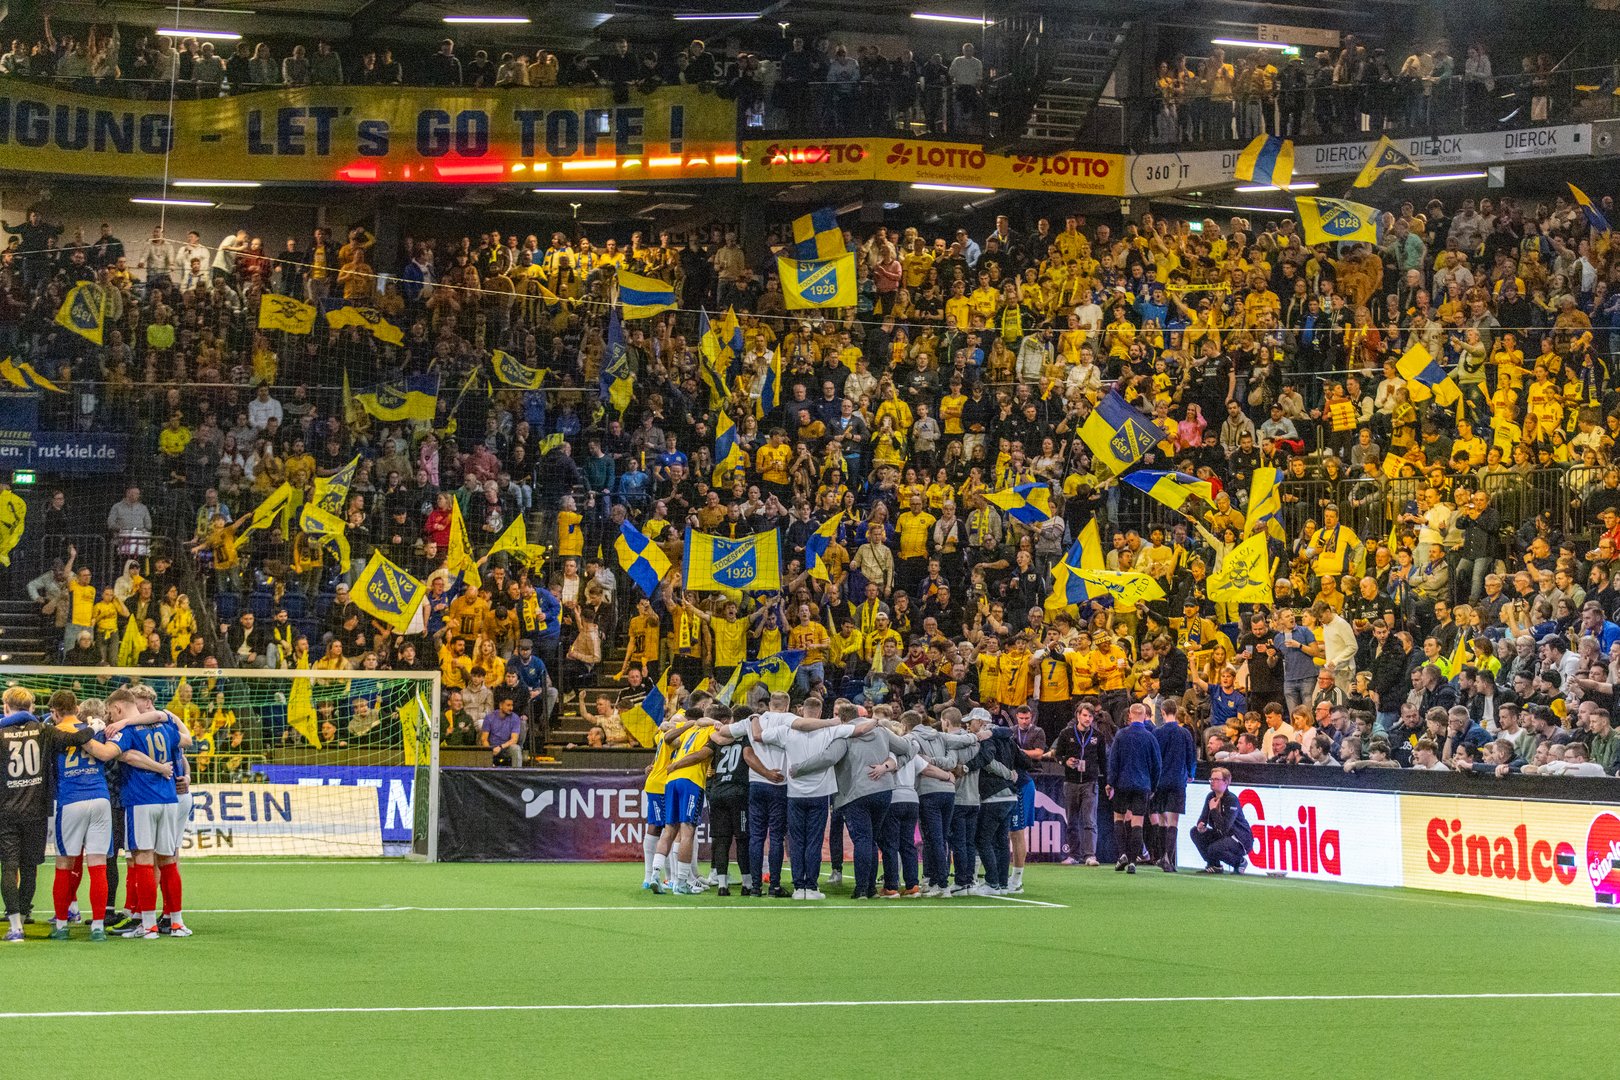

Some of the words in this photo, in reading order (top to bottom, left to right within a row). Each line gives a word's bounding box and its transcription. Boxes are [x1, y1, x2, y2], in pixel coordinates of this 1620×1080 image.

[416, 109, 489, 158] GO
[1504, 130, 1557, 149] DIERCK
[791, 144, 864, 164] LOTTO
[1315, 145, 1368, 164] DIERCK
[1410, 138, 1462, 156] DIERCK
[916, 146, 986, 170] LOTTO
[1041, 156, 1110, 178] LOTTO
[916, 170, 982, 182] Schleswig-Holstein
[1179, 164, 1190, 179] IT
[1041, 178, 1105, 190] Schleswig-Holstein
[1333, 217, 1359, 229] 1928
[800, 262, 815, 272] SV
[810, 283, 836, 296] 1928
[38, 443, 116, 459] rut-kiel.de
[726, 566, 754, 579] 1928
[1047, 661, 1057, 681] 7
[145, 731, 168, 763] 19
[8, 739, 41, 778] 30
[716, 743, 742, 773] 20
[1426, 816, 1578, 886] Sinalco
